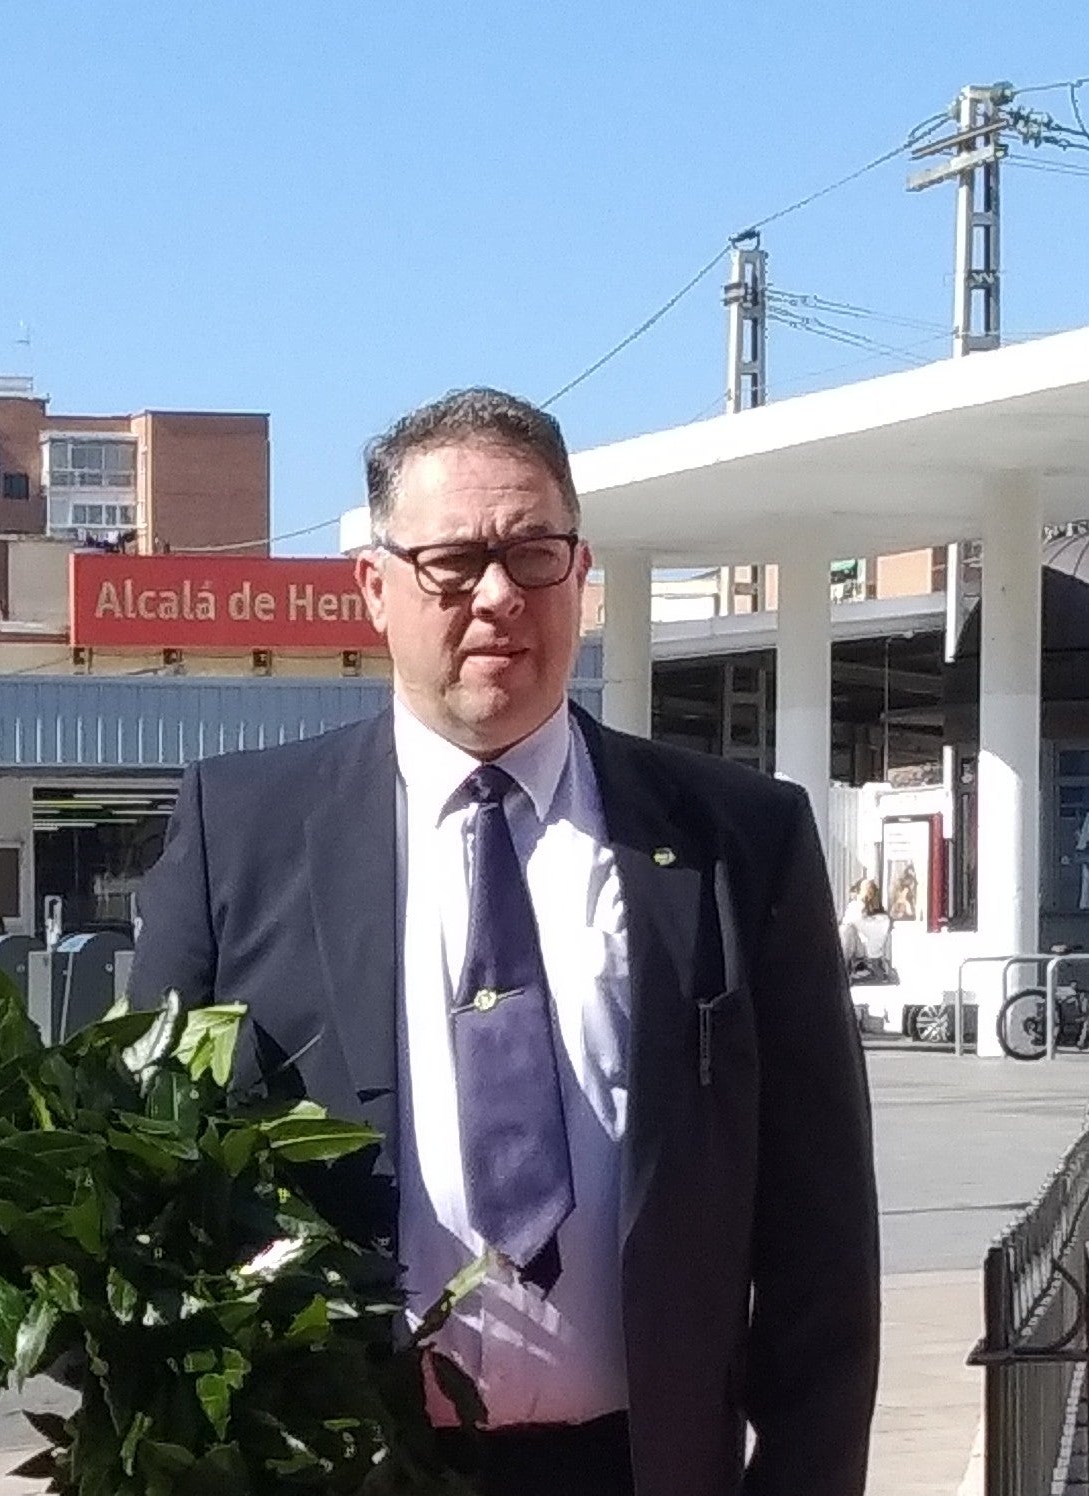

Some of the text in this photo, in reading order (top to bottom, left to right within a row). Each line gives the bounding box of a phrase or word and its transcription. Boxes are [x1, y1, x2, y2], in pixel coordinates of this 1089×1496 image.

[94, 578, 370, 621] Alcalá de Hen
